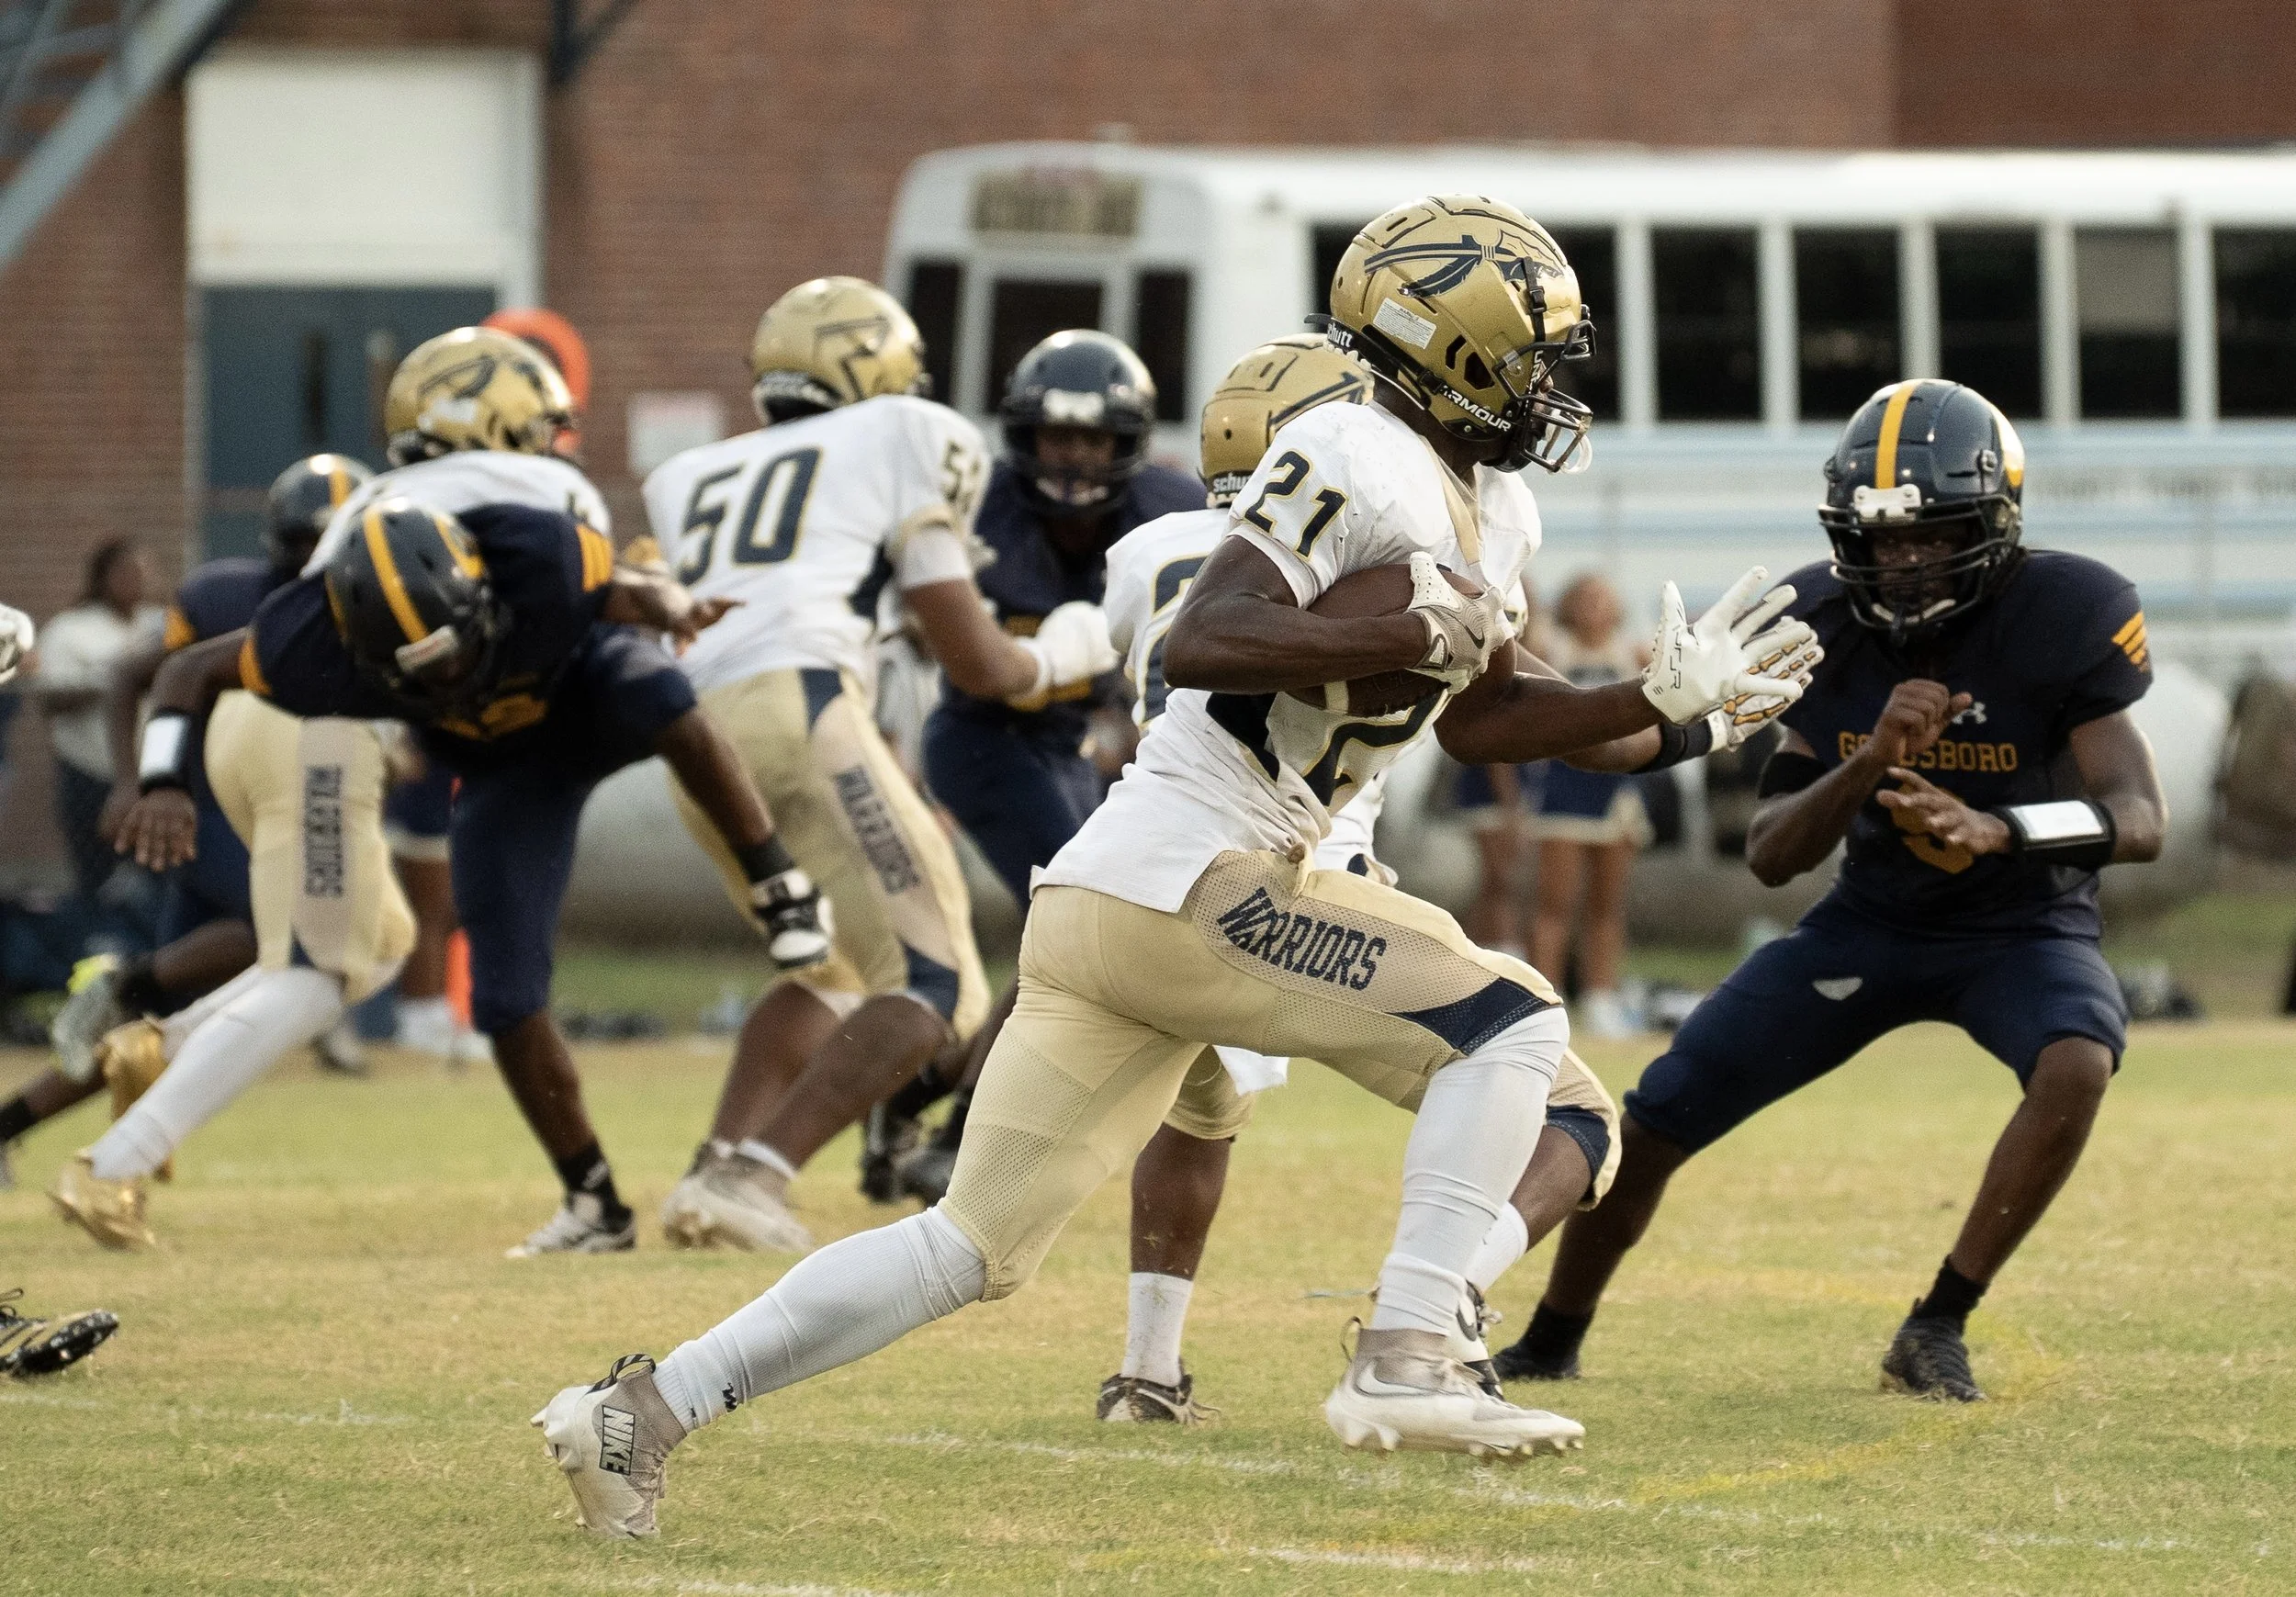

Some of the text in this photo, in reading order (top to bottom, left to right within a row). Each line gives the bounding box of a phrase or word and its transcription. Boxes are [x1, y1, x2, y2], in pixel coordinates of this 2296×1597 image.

[1327, 321, 1353, 348] chutt
[1213, 472, 1252, 493] schu
[1243, 449, 1349, 561] 21
[677, 446, 823, 587] 50
[1838, 731, 2019, 773] GSBORO
[599, 1404, 636, 1476] NIKE
